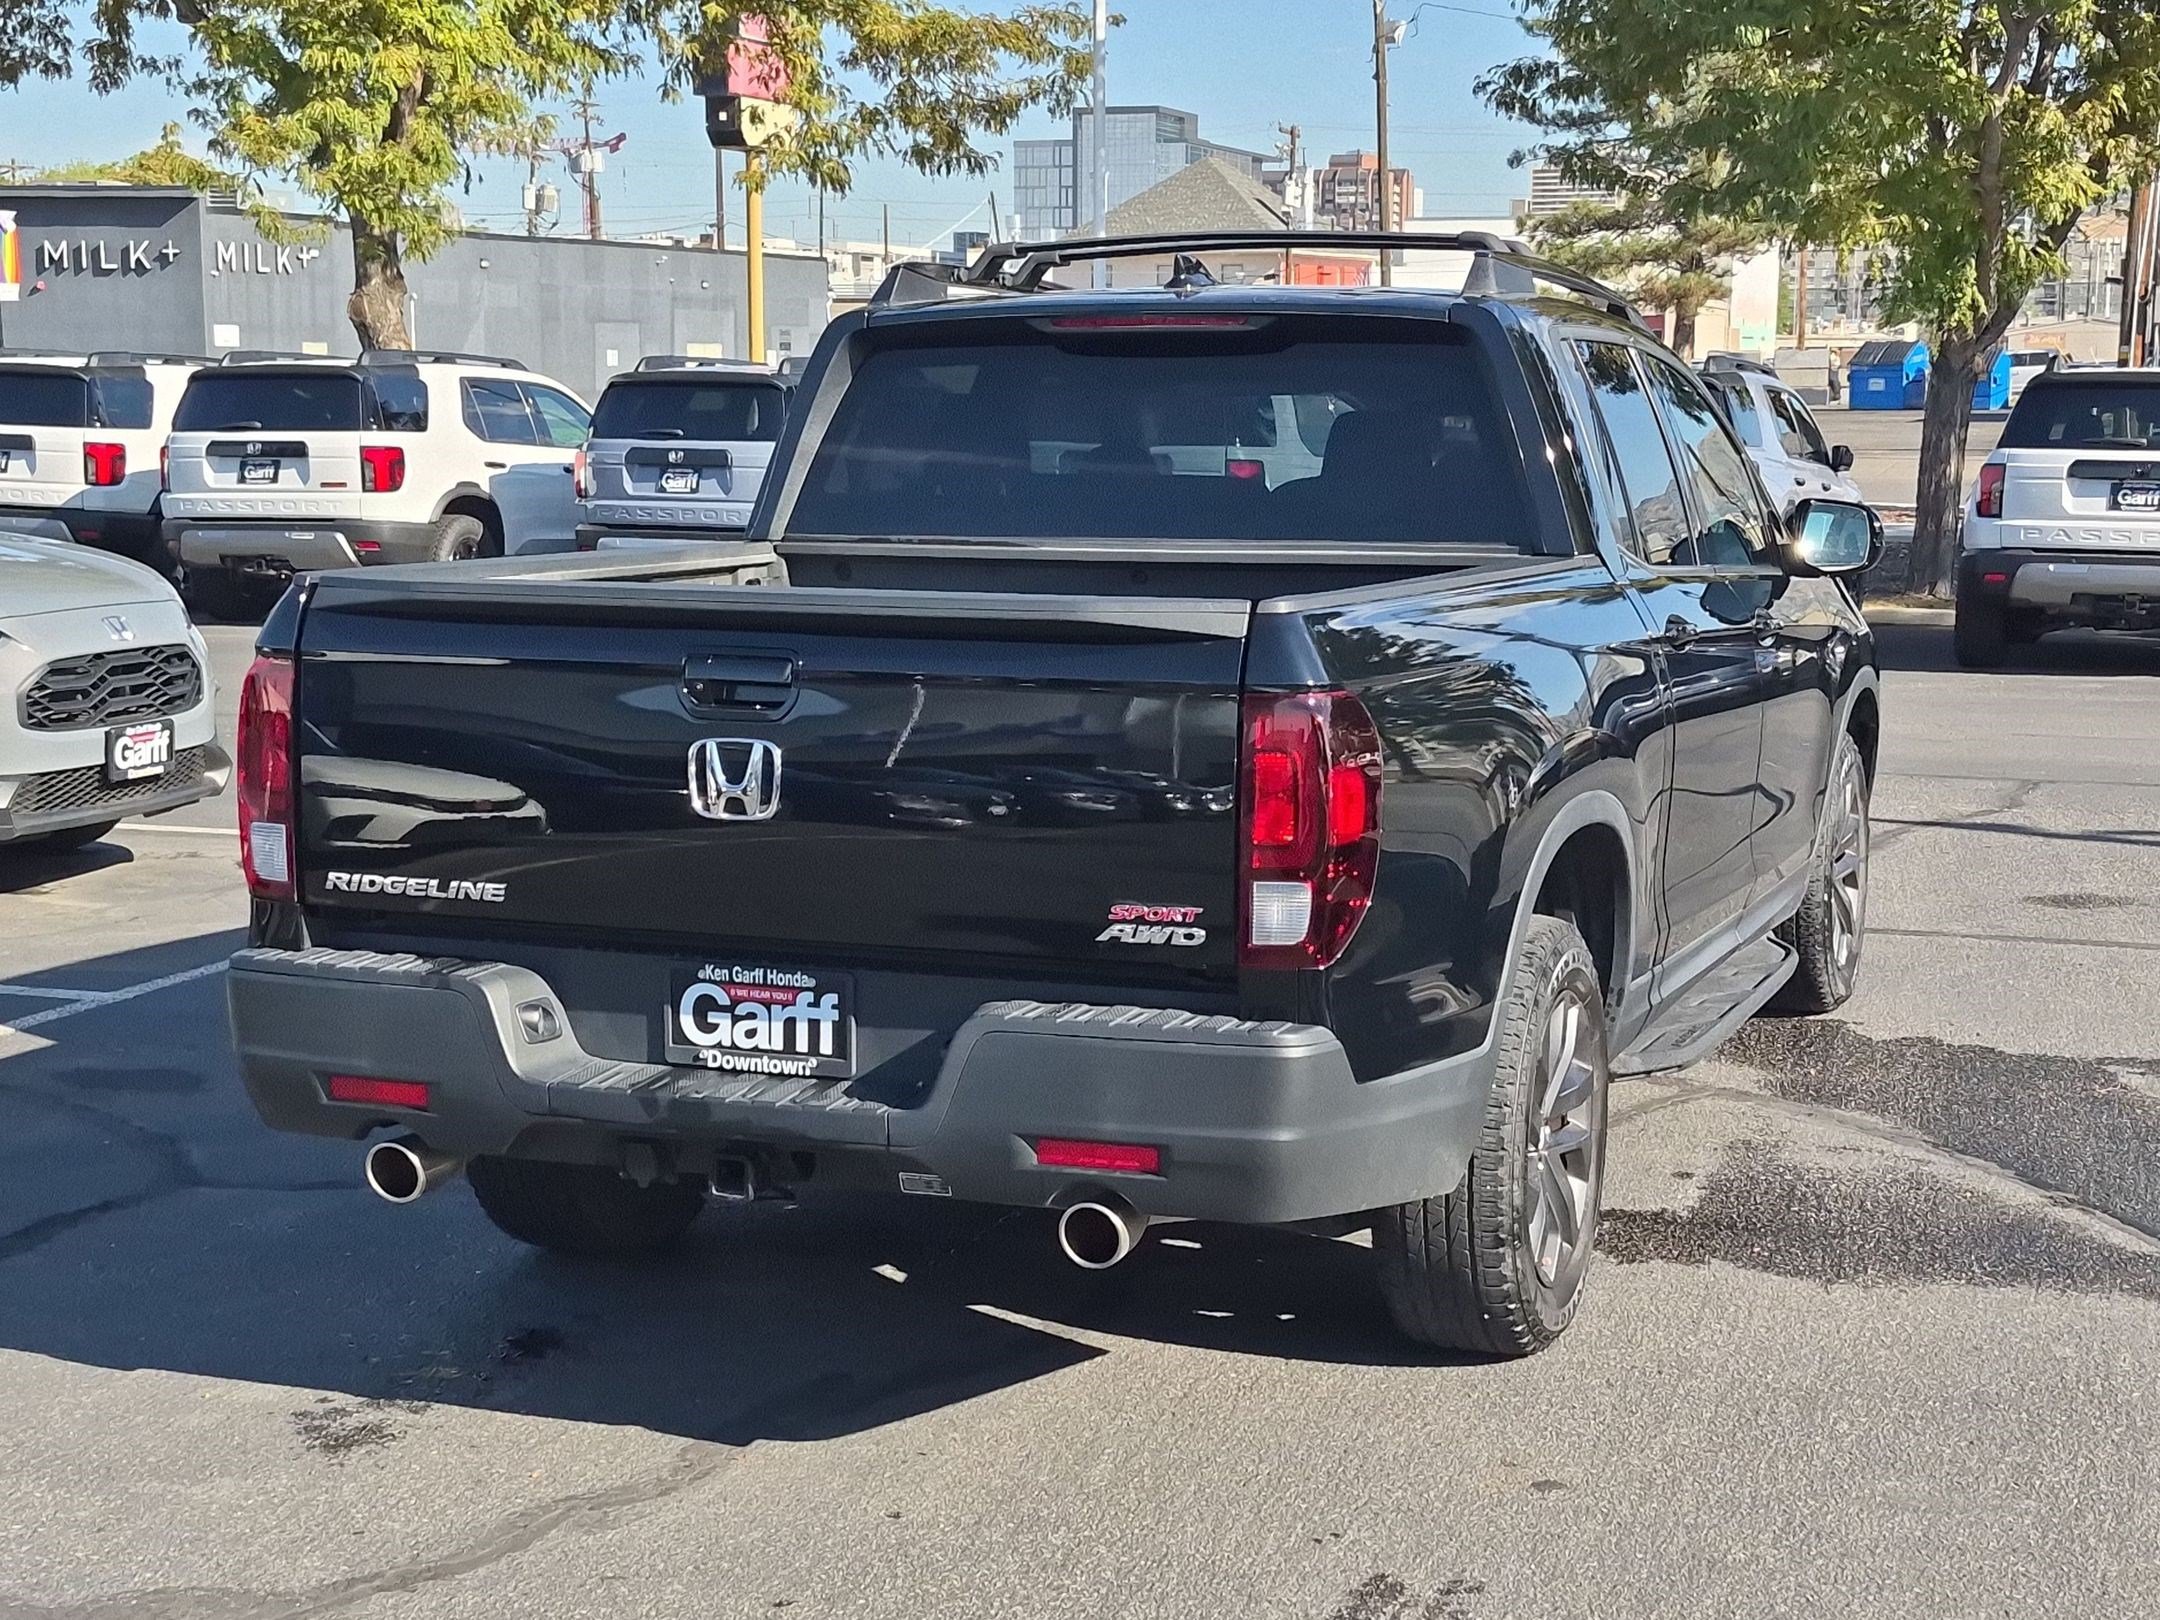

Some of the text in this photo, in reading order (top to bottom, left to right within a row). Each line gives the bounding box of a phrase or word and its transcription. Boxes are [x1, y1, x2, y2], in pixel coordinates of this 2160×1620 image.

[43, 239, 180, 269] MILK+
[661, 472, 699, 489] Garff
[0, 488, 66, 502] ORT
[179, 499, 342, 513] PASSPORT
[596, 507, 750, 522] PASSPOR
[114, 729, 171, 770] Garff
[325, 871, 507, 902] RIDGELINE
[1108, 904, 1204, 923] SPORT
[1095, 923, 1206, 946] AWD
[704, 963, 809, 987] Ken Garff Honda
[735, 988, 788, 1001] WE HEAR YOU
[679, 982, 839, 1056] Garff
[706, 1050, 811, 1076] Downtown
